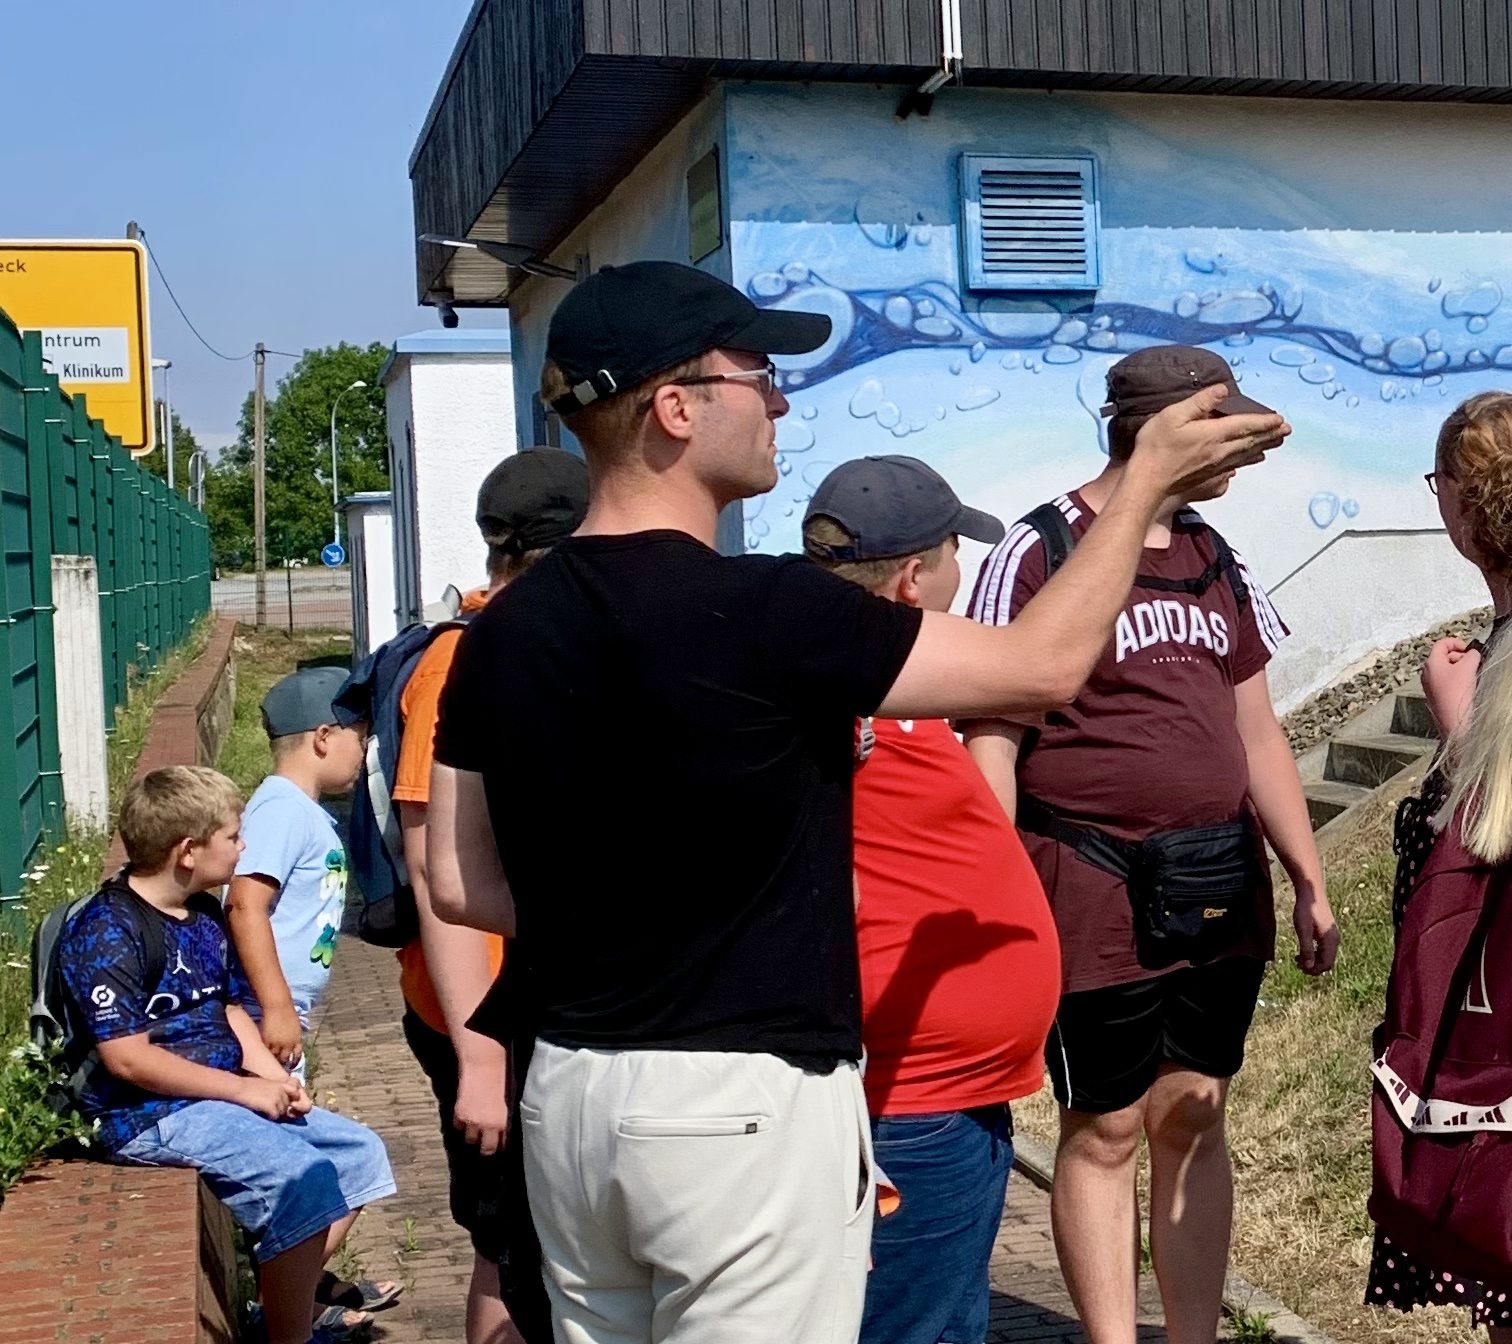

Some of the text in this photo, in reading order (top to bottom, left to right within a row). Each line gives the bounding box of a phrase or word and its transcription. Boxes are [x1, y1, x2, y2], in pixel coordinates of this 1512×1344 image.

[44, 334, 101, 347] ntrum
[63, 363, 124, 378] Klinikum
[1115, 599, 1229, 664] ADIDAS
